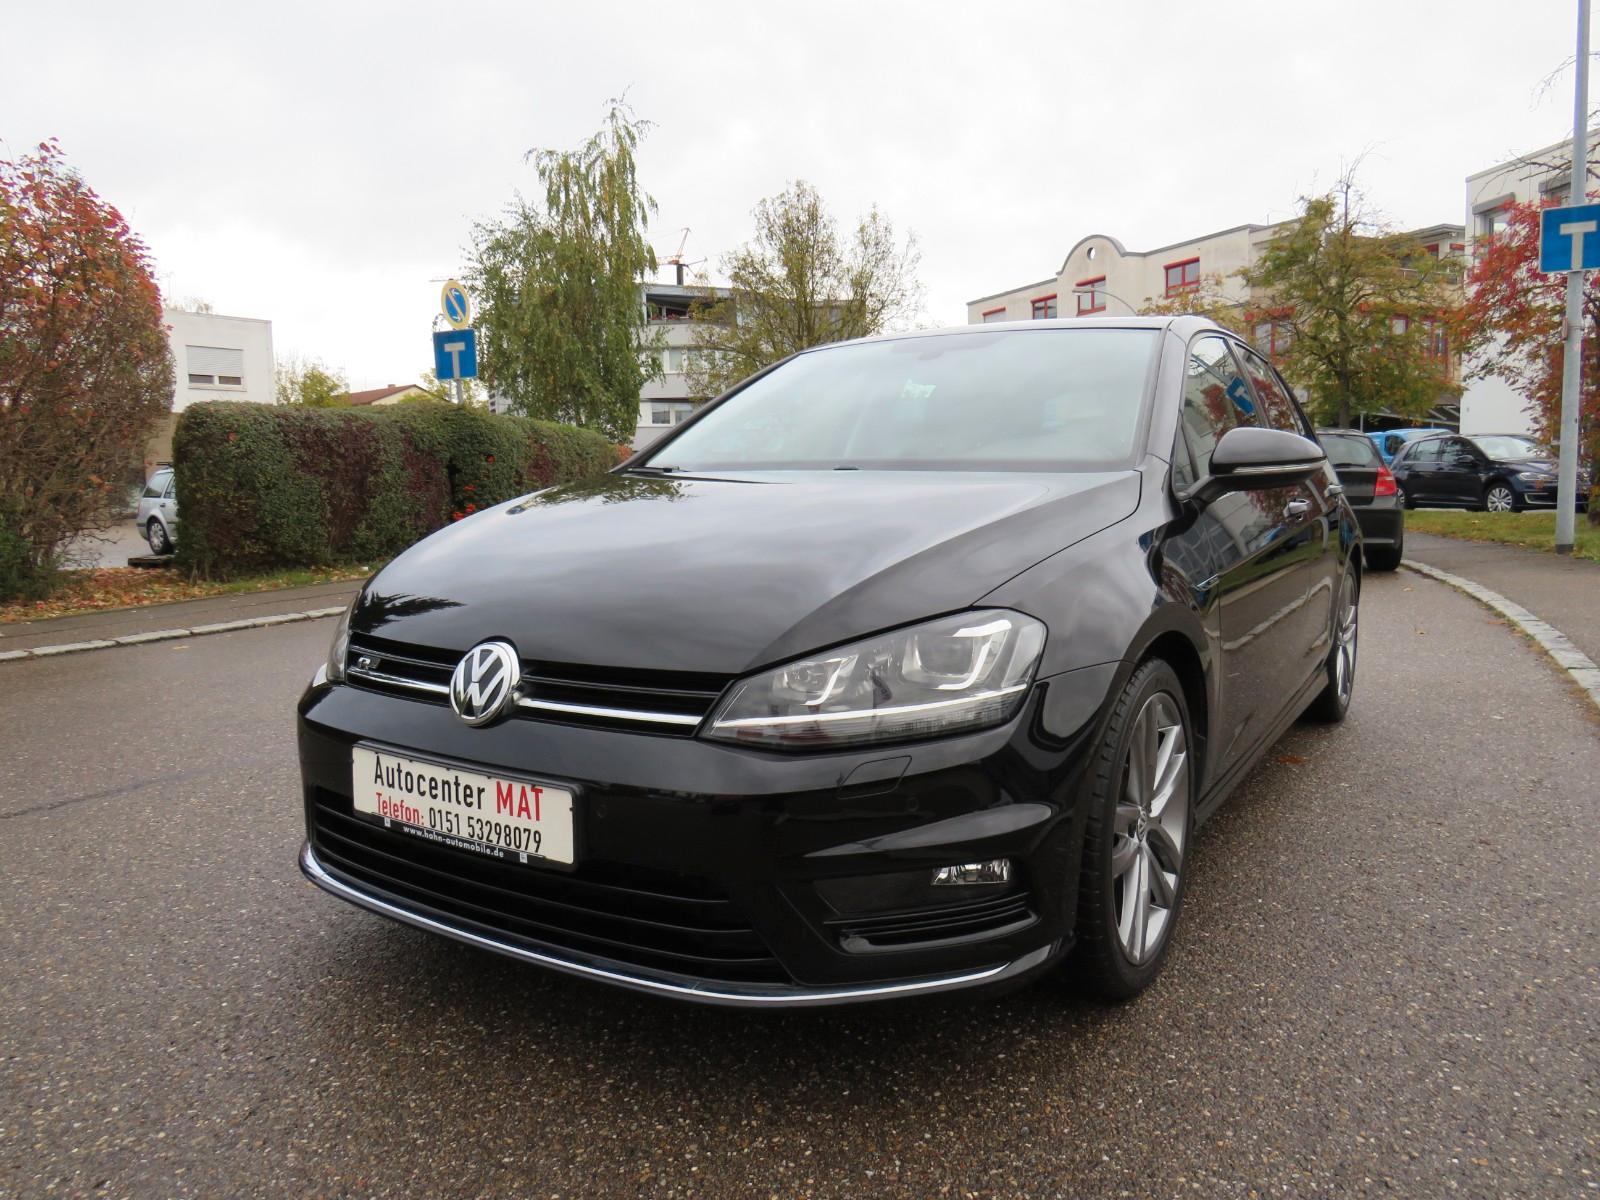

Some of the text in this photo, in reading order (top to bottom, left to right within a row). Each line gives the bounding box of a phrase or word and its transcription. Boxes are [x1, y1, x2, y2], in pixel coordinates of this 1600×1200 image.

[375, 755, 543, 821] Autocenter MAT
[376, 792, 542, 853] Telefon: 0151 53298079
